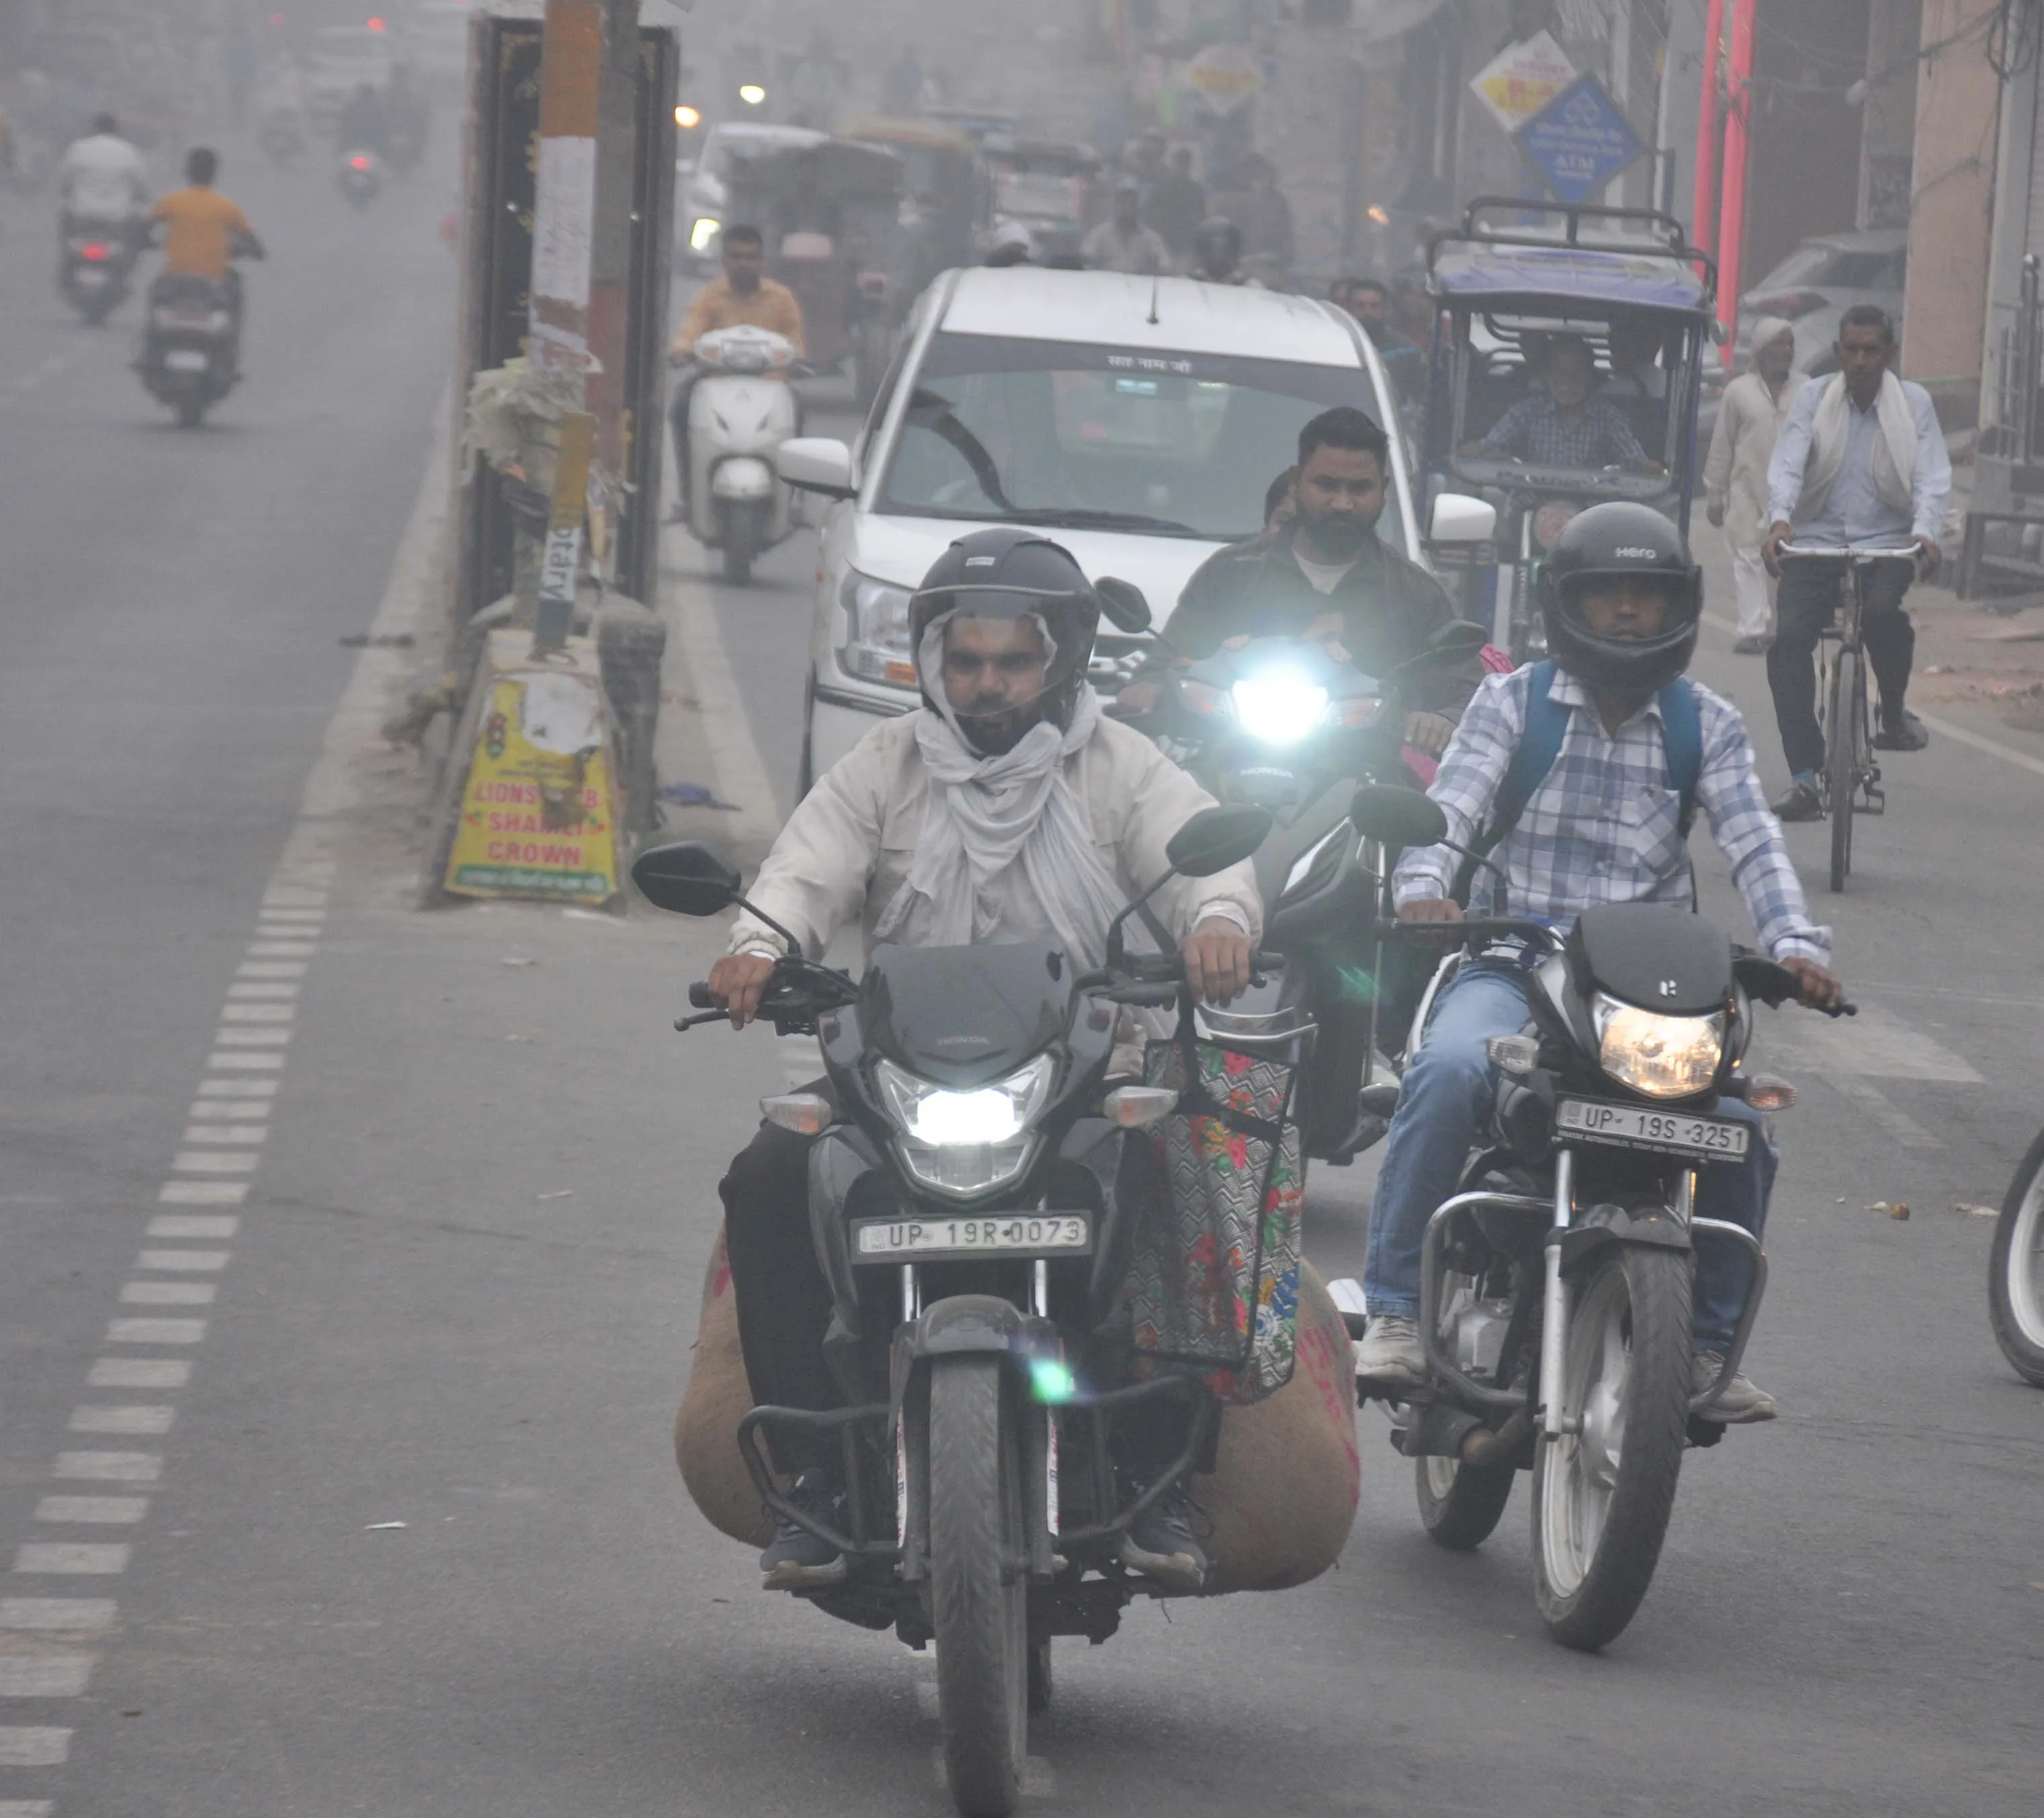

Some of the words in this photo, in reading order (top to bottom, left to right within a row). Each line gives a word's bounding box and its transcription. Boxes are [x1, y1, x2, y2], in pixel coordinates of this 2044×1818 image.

[1135, 357, 1168, 370] नाम
[1170, 359, 1192, 373] जी
[474, 782, 536, 804] LIONS
[488, 841, 581, 865] CROWN
[1586, 1108, 1613, 1129] UP
[1637, 1114, 1677, 1141] 19S
[1690, 1123, 1743, 1151] 3251
[890, 1224, 923, 1246] UP
[947, 1221, 997, 1246] 19R
[1009, 1220, 1081, 1243] 0073
